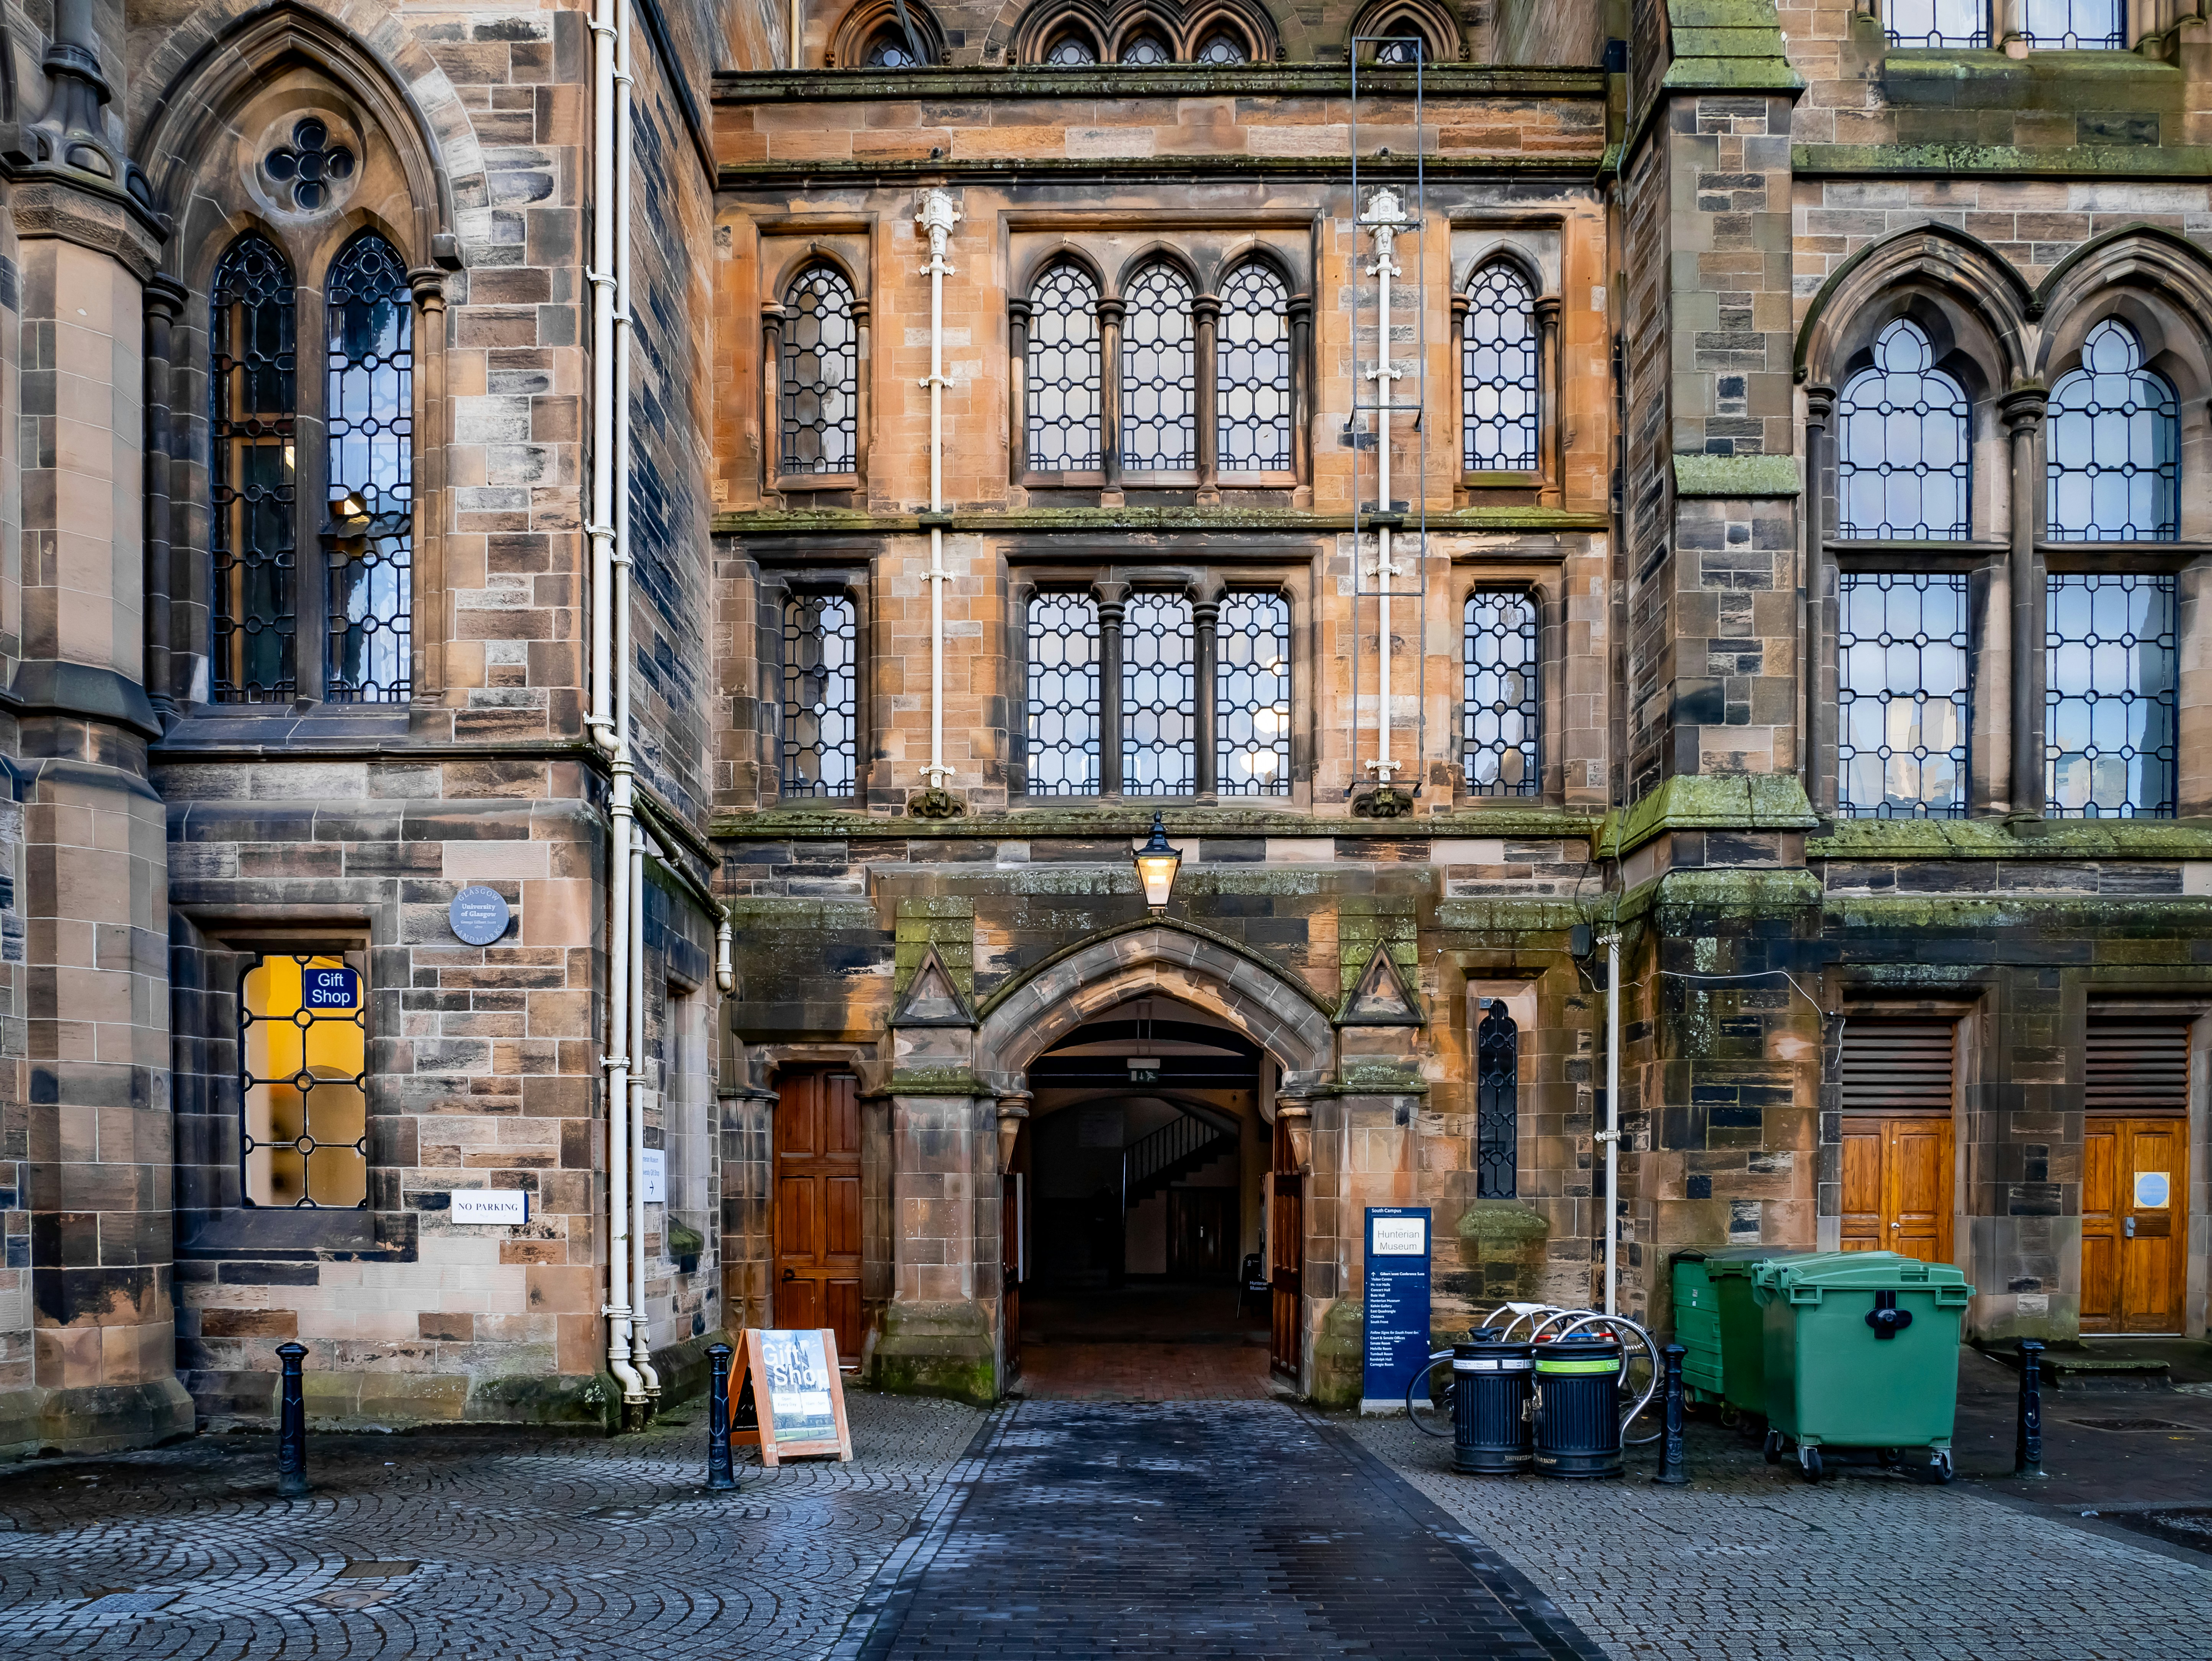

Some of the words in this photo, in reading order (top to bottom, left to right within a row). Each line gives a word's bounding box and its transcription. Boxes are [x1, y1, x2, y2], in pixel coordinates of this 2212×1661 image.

[458, 888, 499, 901] GLASGOW
[453, 924, 504, 943] LANDMARKS
[318, 973, 344, 986] Gift
[312, 989, 350, 1006] Shop
[1378, 1230, 1420, 1238] Hunterian
[762, 1344, 800, 1365] Gift
[772, 1364, 830, 1391] Shop
